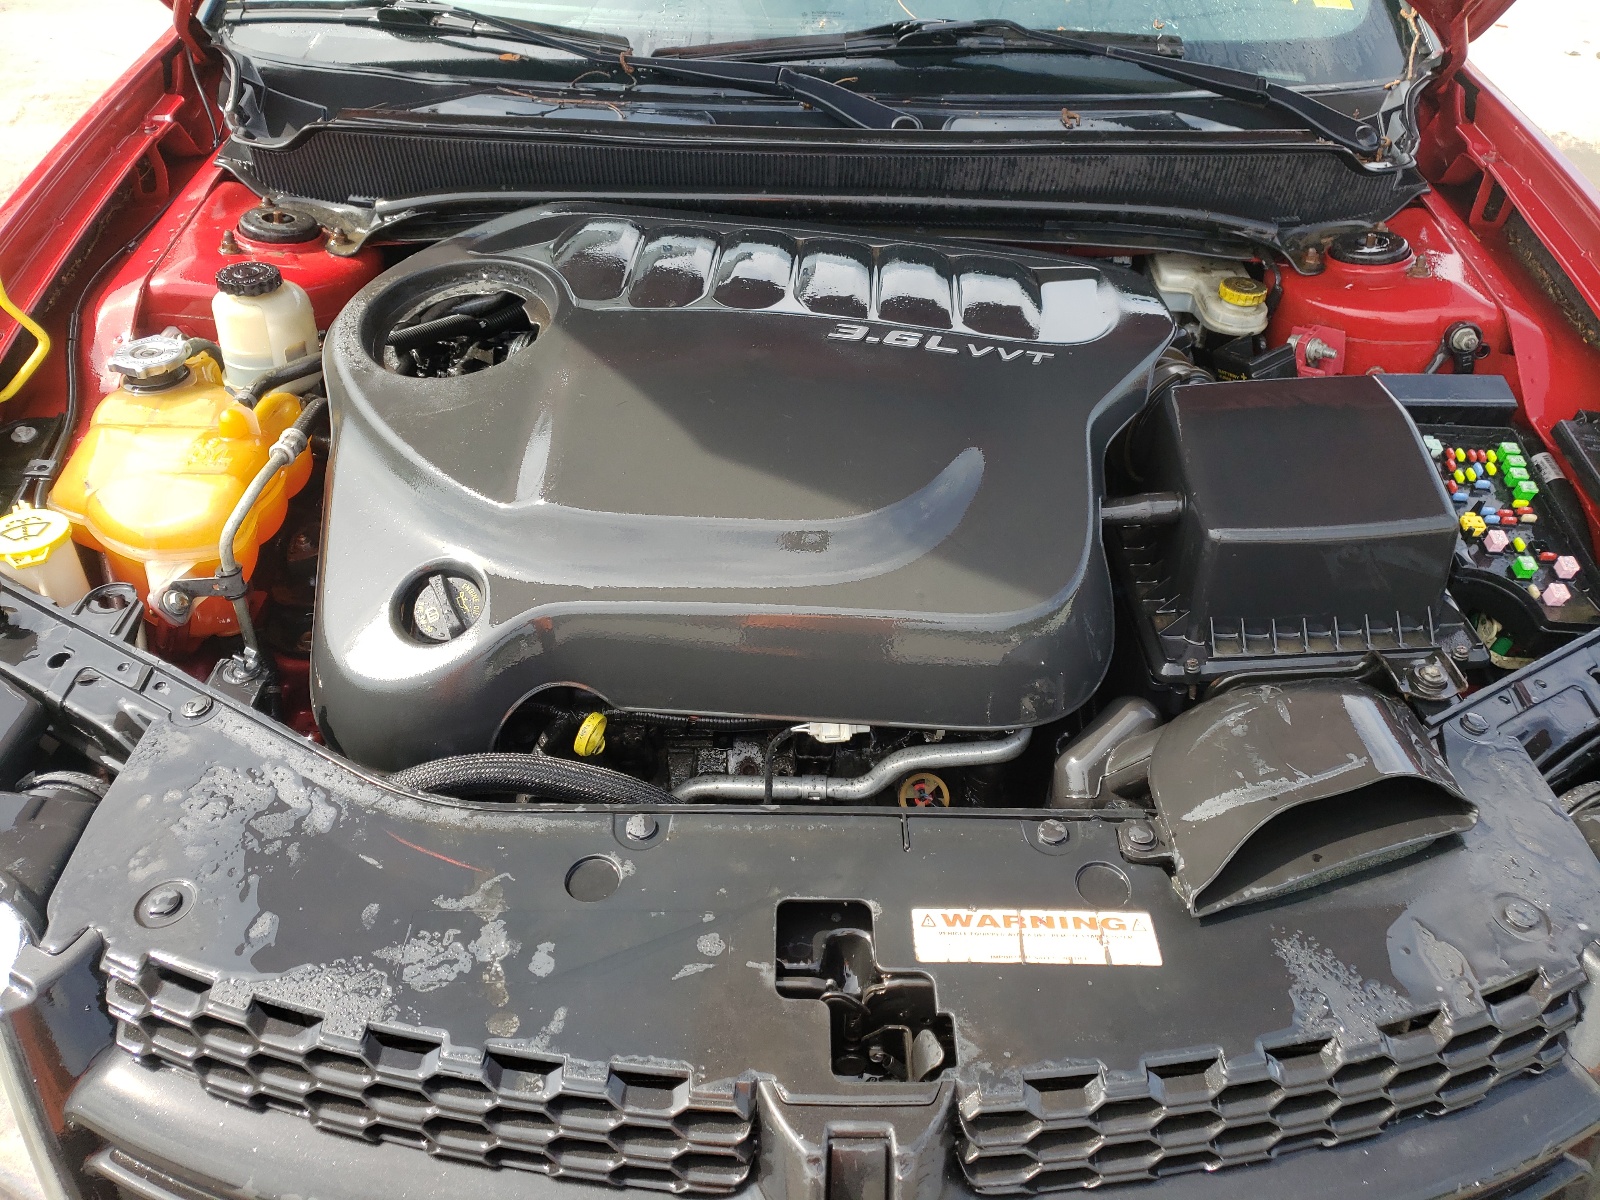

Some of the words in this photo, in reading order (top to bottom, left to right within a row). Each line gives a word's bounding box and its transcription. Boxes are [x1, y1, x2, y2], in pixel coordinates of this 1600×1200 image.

[825, 323, 960, 354] 3.6L
[967, 342, 1055, 366] VVT
[462, 584, 479, 603] ENGINE
[940, 913, 1128, 931] WARNING
